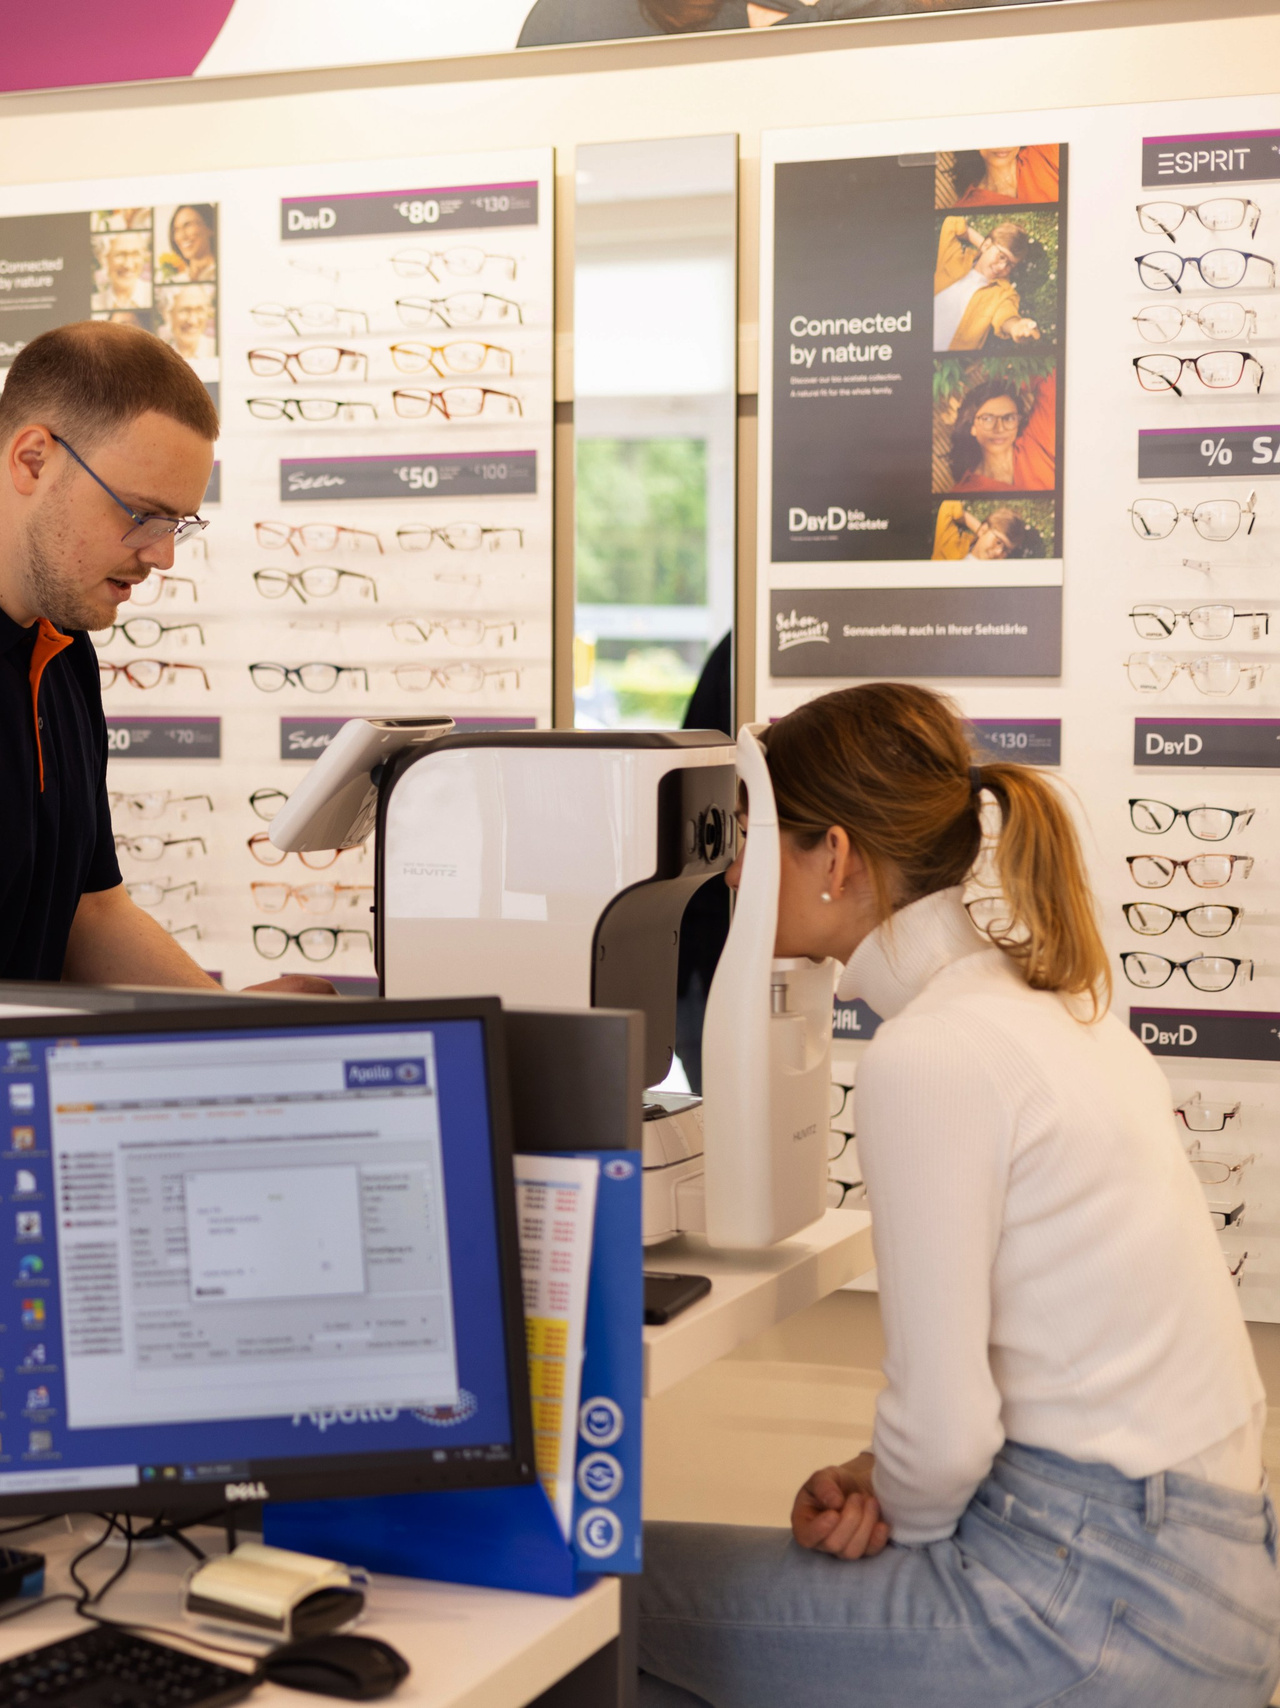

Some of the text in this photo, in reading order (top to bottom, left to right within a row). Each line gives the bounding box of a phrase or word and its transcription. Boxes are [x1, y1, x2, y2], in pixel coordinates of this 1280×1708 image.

[1158, 148, 1251, 174] ESPRIT
[399, 200, 440, 224] €80
[790, 310, 912, 337] Connected
[790, 342, 893, 368] by nature
[839, 387, 851, 396] the
[1200, 438, 1233, 466] %
[398, 466, 439, 489] €50
[847, 509, 866, 521] bio
[847, 519, 889, 530] acetate
[843, 623, 1028, 637] Sonnenbrille auch in Ihrer Sehstärke
[403, 867, 457, 878] HUVITZ
[348, 1064, 394, 1084] Apollo
[225, 1481, 269, 1500] DELL
